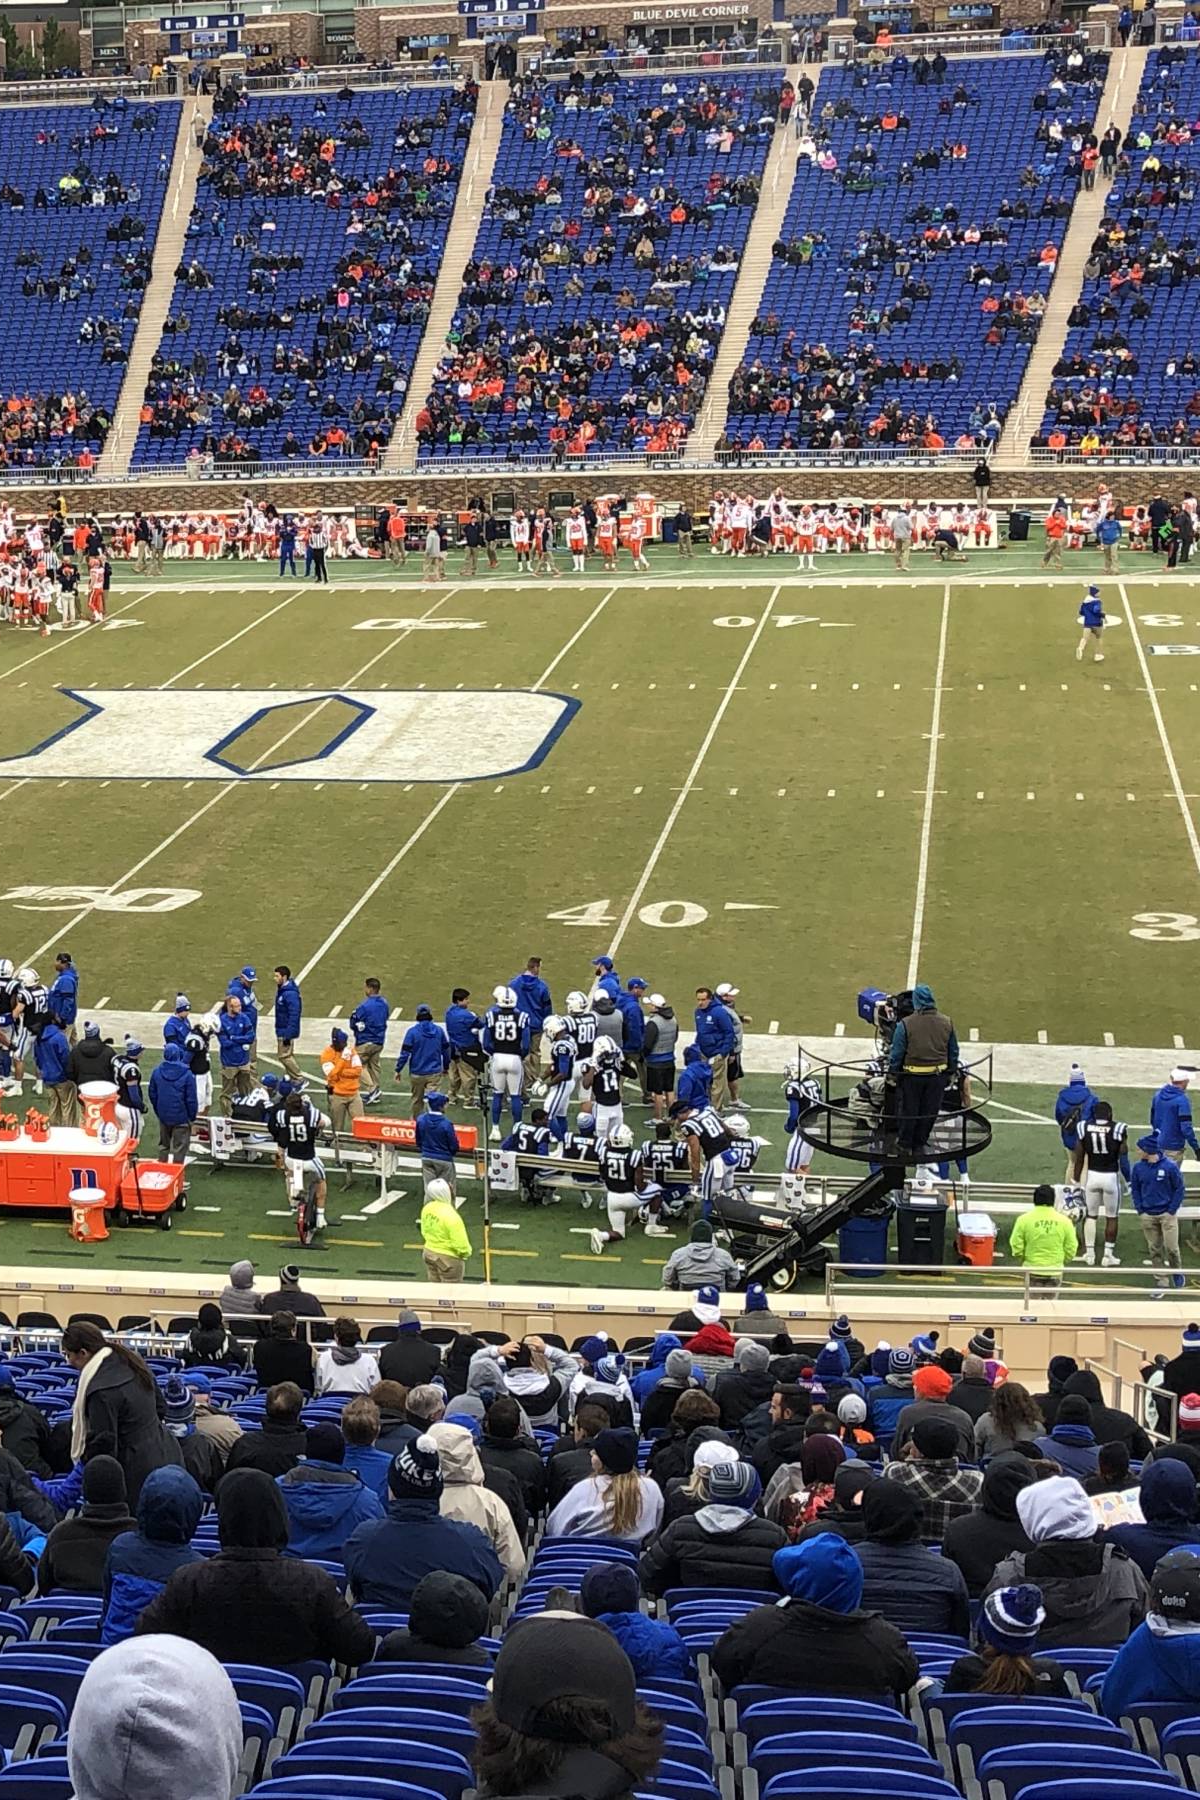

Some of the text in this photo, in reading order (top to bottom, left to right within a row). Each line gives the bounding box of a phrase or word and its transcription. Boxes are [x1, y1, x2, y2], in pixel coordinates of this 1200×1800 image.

[633, 5, 749, 20] BLUE DEVIL CORNER
[546, 899, 710, 928] 40
[495, 1021, 517, 1041] 83
[578, 1024, 595, 1043] 80
[602, 1070, 619, 1092] 14
[87, 1104, 100, 1119] G
[289, 1124, 308, 1142] 19
[701, 1114, 725, 1138] 81
[518, 1130, 529, 1150] 5
[1091, 1133, 1109, 1154] 11
[577, 1144, 588, 1161] 7
[607, 1158, 627, 1181] 21
[651, 1152, 675, 1177] 25
[73, 1209, 86, 1224] G
[1162, 1595, 1186, 1608] duke
